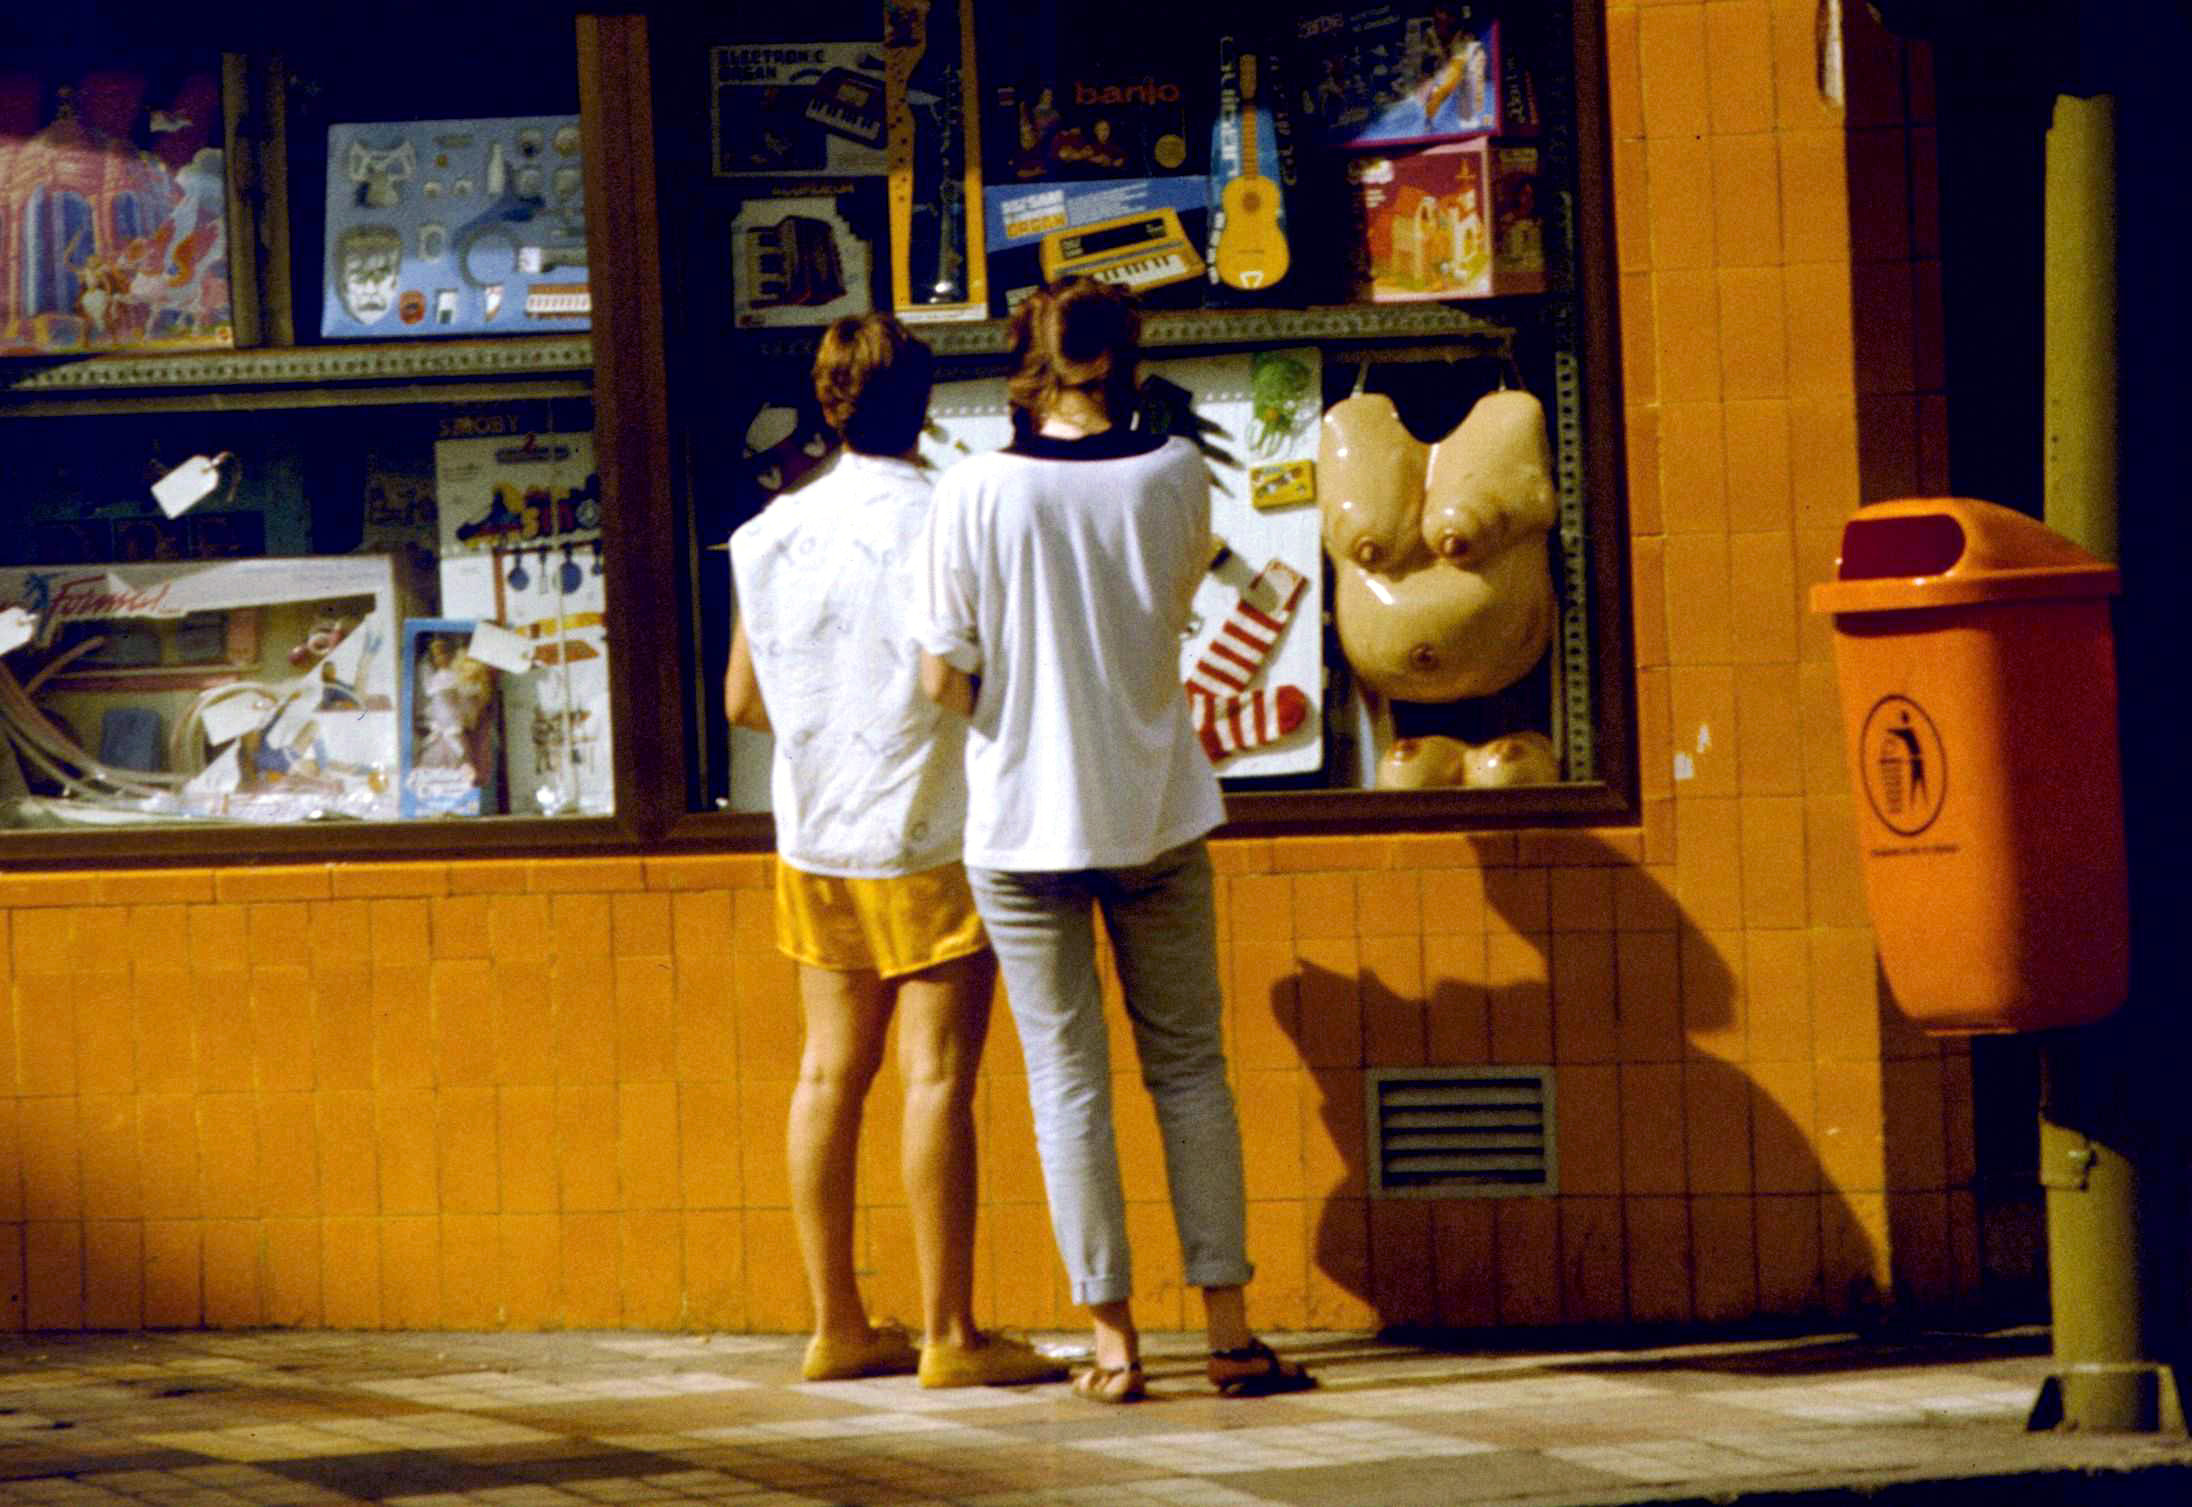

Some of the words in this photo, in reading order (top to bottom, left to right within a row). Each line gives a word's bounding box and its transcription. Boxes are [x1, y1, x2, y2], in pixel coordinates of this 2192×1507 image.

[719, 49, 826, 65] ELECTRONC
[1074, 79, 1181, 106] banjo
[438, 415, 521, 437] SMOBY
